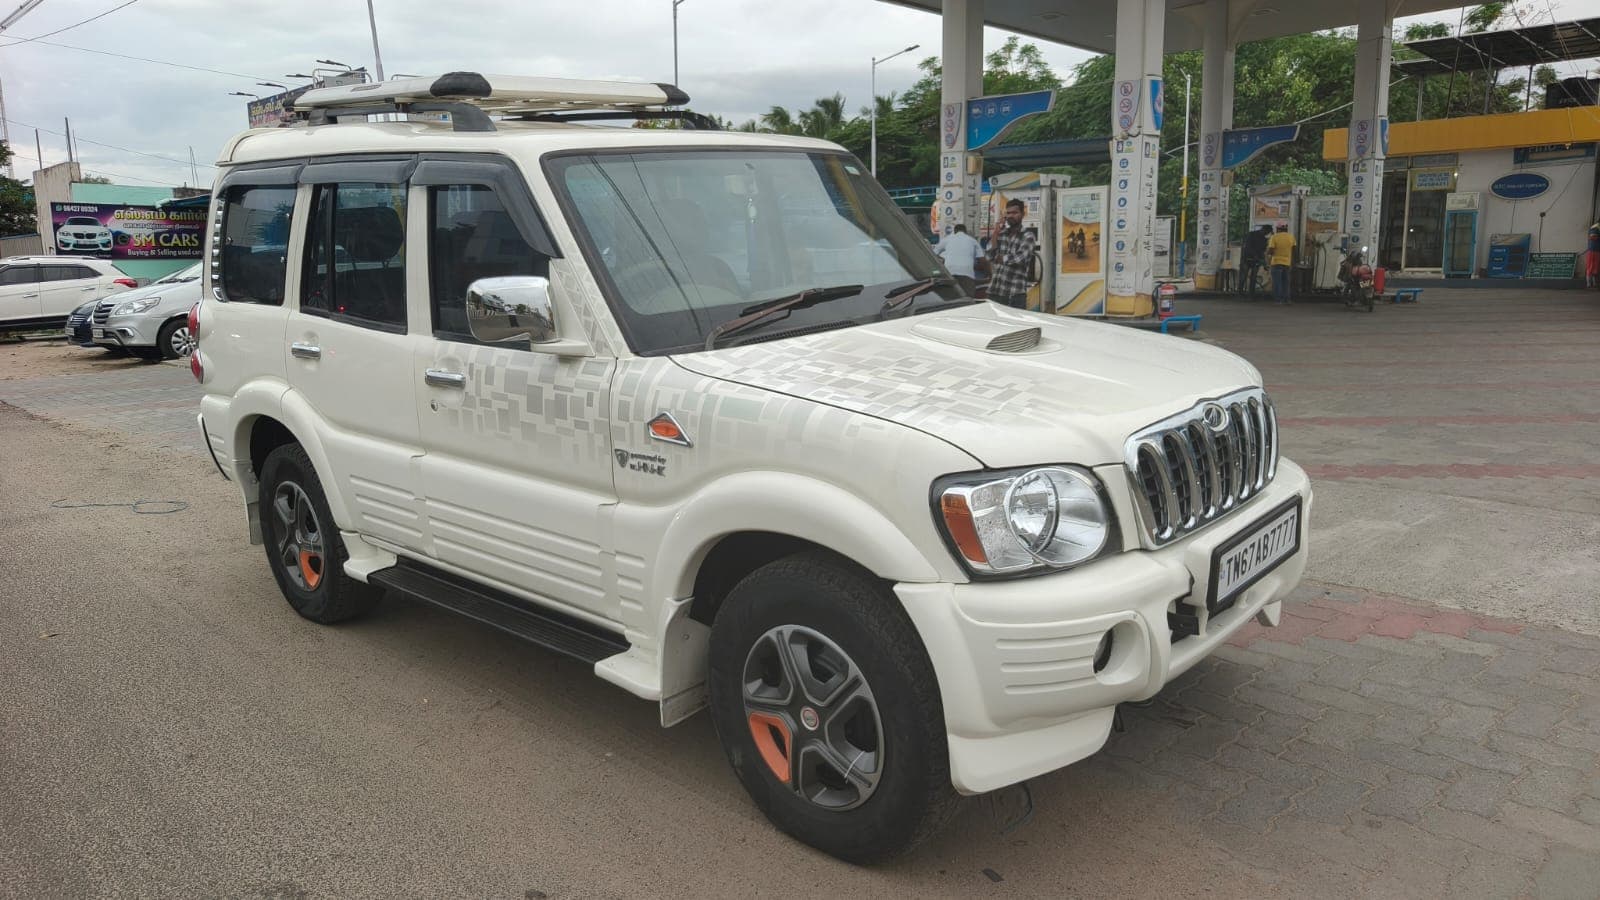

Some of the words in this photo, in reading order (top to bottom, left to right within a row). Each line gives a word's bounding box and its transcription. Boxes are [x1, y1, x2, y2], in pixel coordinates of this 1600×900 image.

[133, 233, 155, 247] SM
[159, 233, 199, 247] CARS
[127, 248, 149, 257] Buying
[157, 248, 177, 257] Selling
[178, 248, 191, 256] used
[1226, 514, 1295, 586] TN67AB7777
